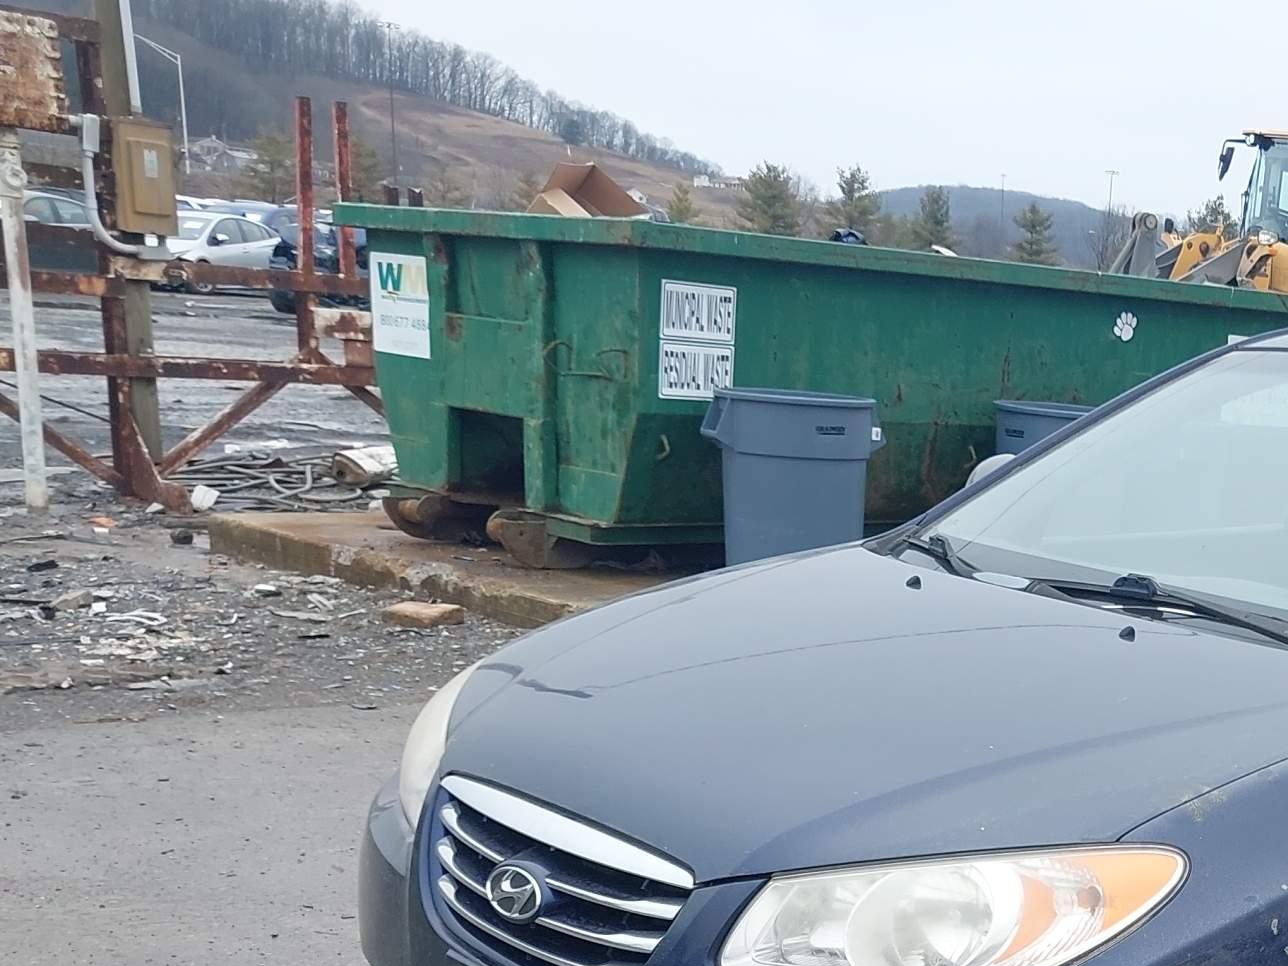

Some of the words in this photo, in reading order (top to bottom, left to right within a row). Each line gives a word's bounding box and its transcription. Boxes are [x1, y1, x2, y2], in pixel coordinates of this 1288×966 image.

[665, 290, 705, 333] MUNICIPAL
[706, 294, 732, 336] WASTE
[664, 350, 701, 391] RESIDUAL
[703, 353, 730, 392] WASTE
